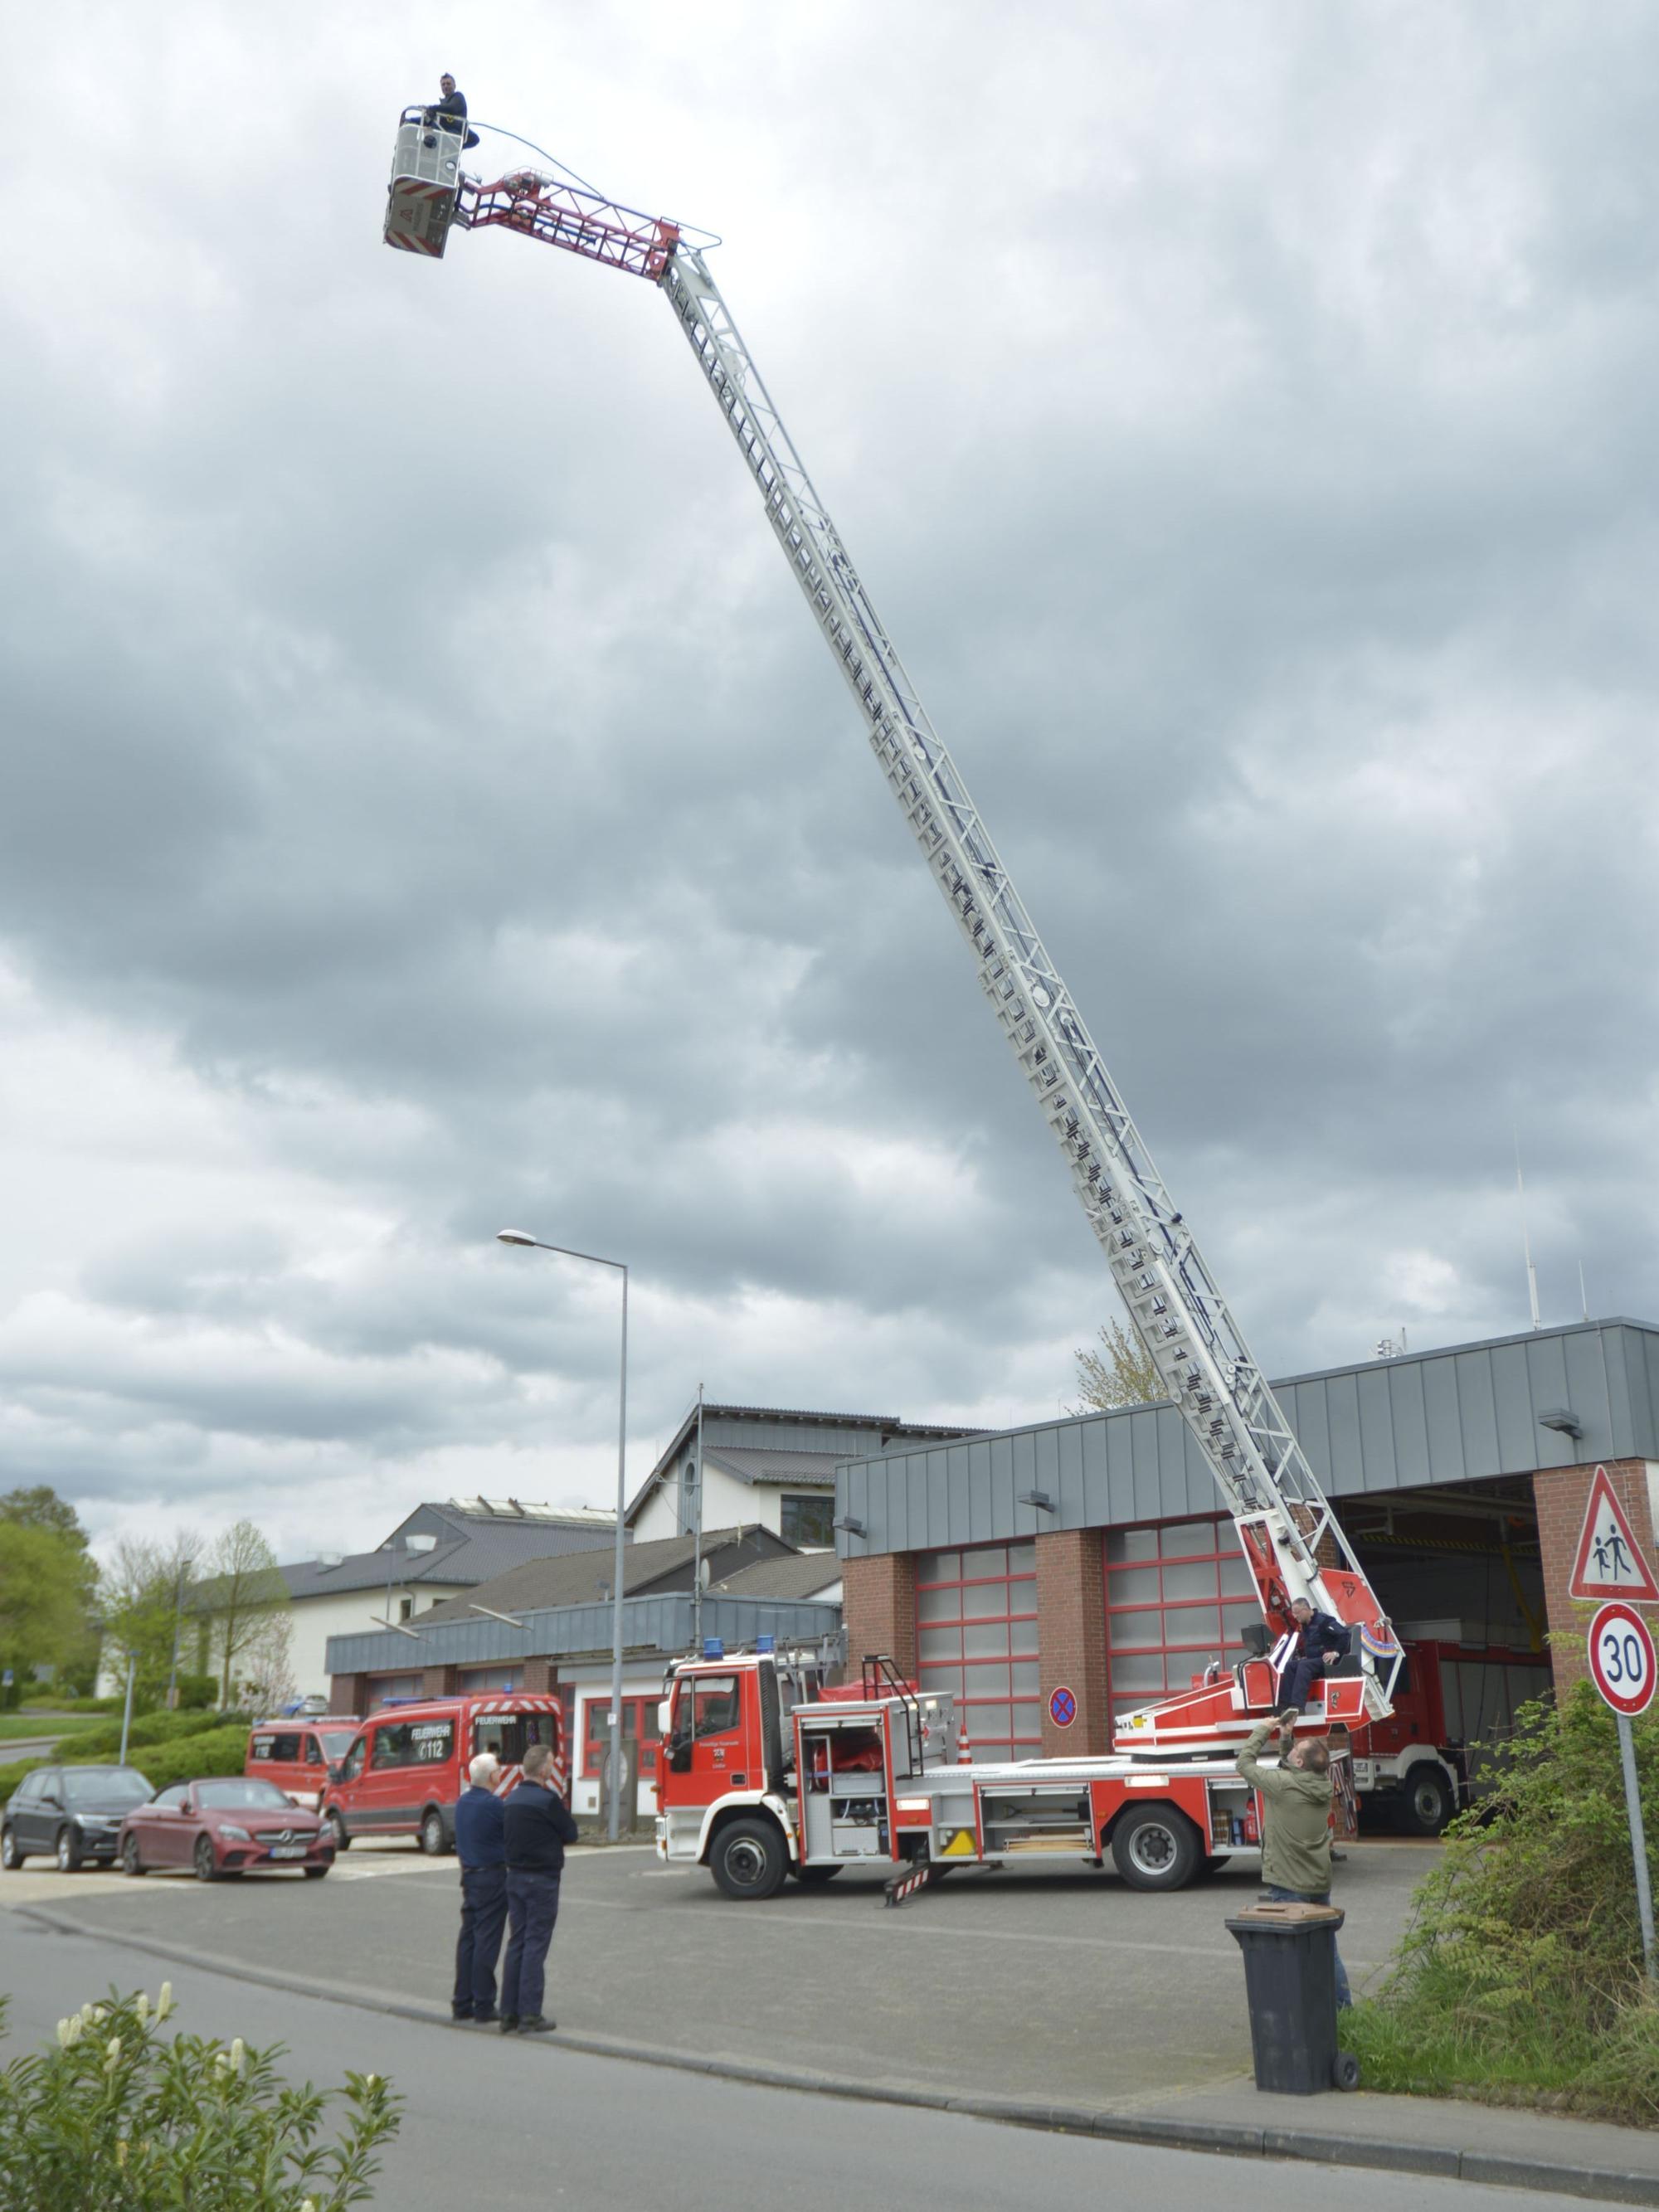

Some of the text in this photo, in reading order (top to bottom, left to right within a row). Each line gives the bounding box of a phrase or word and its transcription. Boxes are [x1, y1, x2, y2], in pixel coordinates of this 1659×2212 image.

[1603, 1634, 1642, 1683] 30
[475, 1715, 517, 1726] FEUERWEHR
[411, 1725, 450, 1740] FEUERWEHR
[427, 1740, 443, 1758] 112
